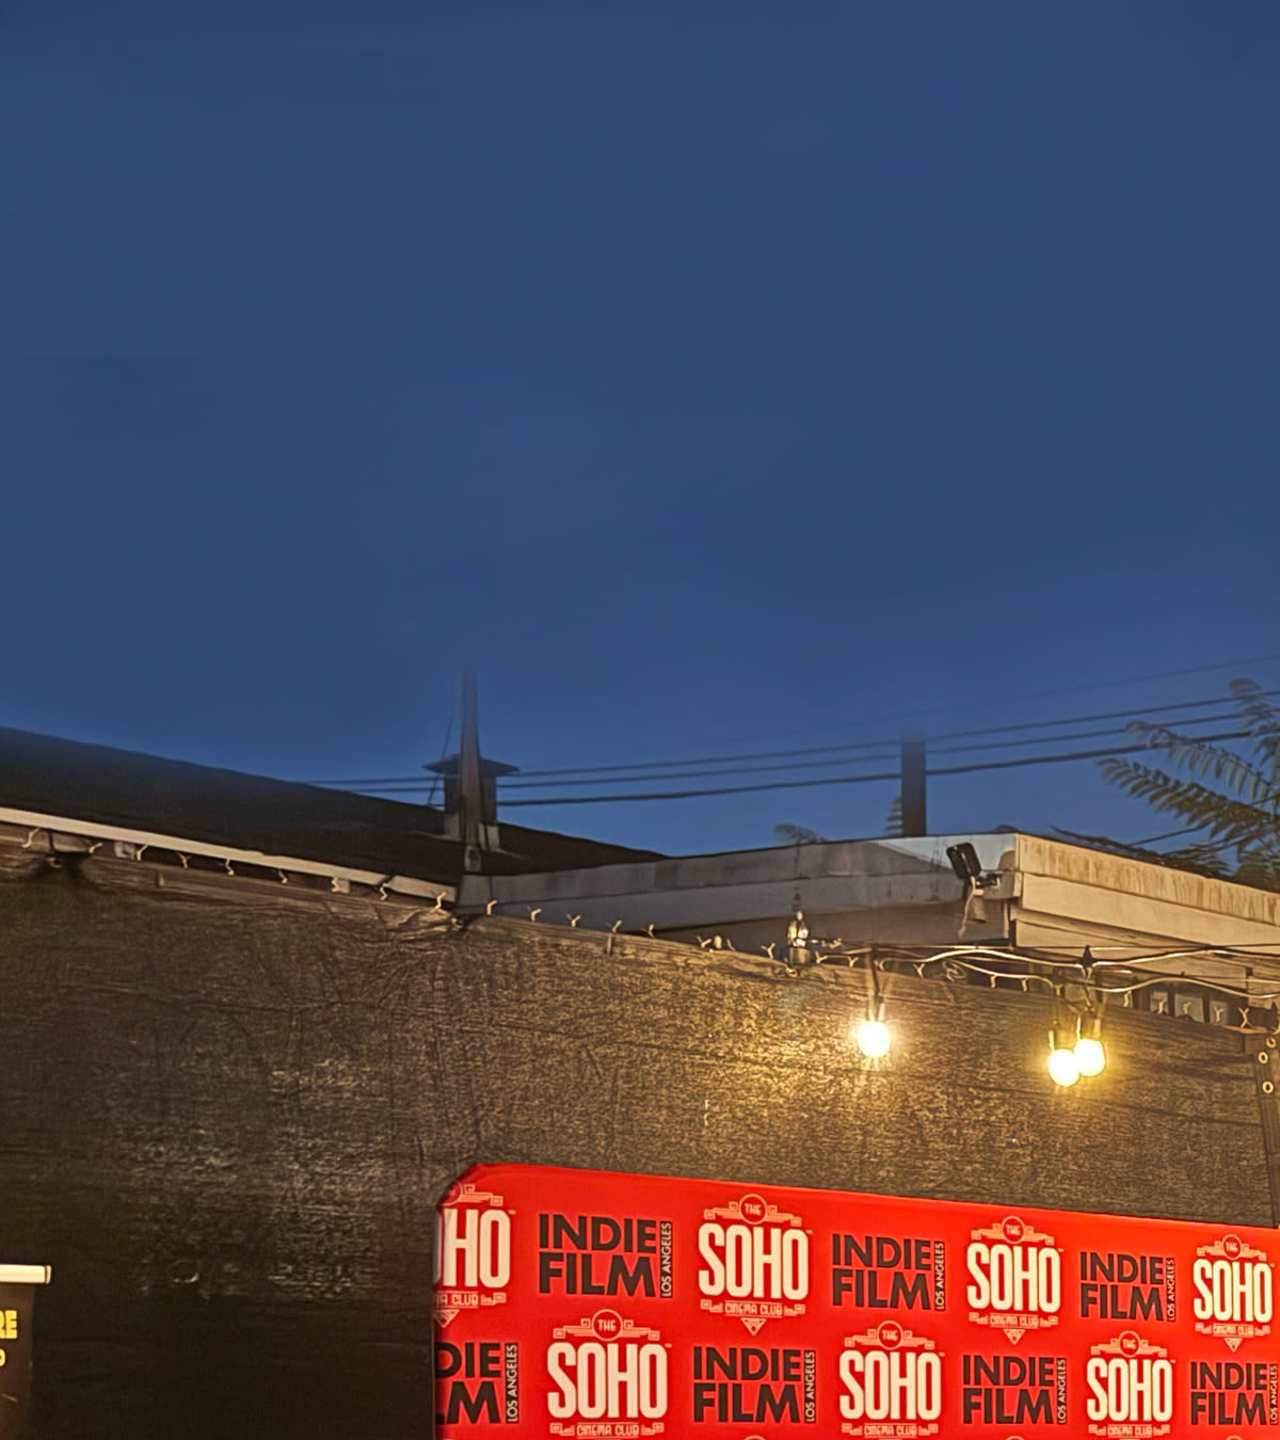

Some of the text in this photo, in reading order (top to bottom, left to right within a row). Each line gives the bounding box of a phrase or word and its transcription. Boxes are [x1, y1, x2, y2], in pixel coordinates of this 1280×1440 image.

[437, 1208, 512, 1289] HO
[539, 1214, 657, 1254] INDIE
[832, 1233, 931, 1270] INDIE
[539, 1251, 657, 1297] FILM
[698, 1222, 809, 1300] SOHO
[967, 1242, 1061, 1313] SOHO
[1080, 1251, 1164, 1285] INDIE
[832, 1267, 931, 1310] FILM
[1080, 1283, 1164, 1321] FILM
[1193, 1258, 1273, 1323] SOHO
[598, 1319, 616, 1332] THE
[435, 1341, 501, 1378] DIE
[693, 1346, 801, 1381] INDIE
[963, 1355, 1055, 1387] INDIE
[1190, 1362, 1267, 1391] INDIE
[547, 1342, 668, 1419] SOHO
[839, 1350, 942, 1420] SOHO
[1087, 1357, 1173, 1422] SOHO
[693, 1382, 801, 1423] FILM
[963, 1387, 1054, 1425] FILM
[1190, 1391, 1267, 1425] FILM
